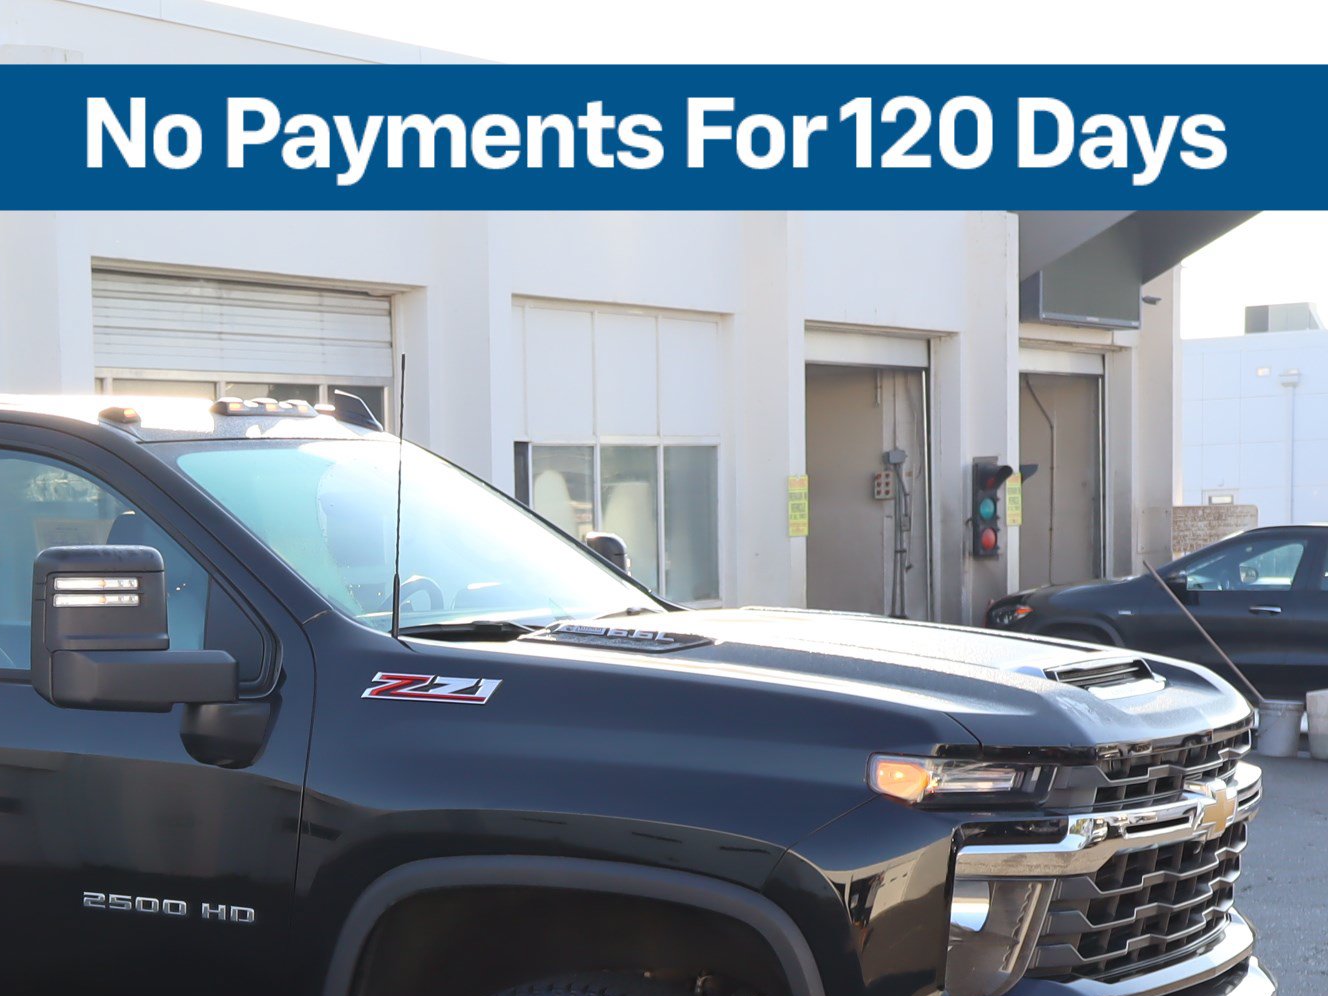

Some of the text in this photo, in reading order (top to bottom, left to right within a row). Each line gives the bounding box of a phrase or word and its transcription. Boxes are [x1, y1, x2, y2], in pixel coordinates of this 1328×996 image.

[361, 672, 503, 705] Z71
[83, 891, 255, 923] 2500 HD
